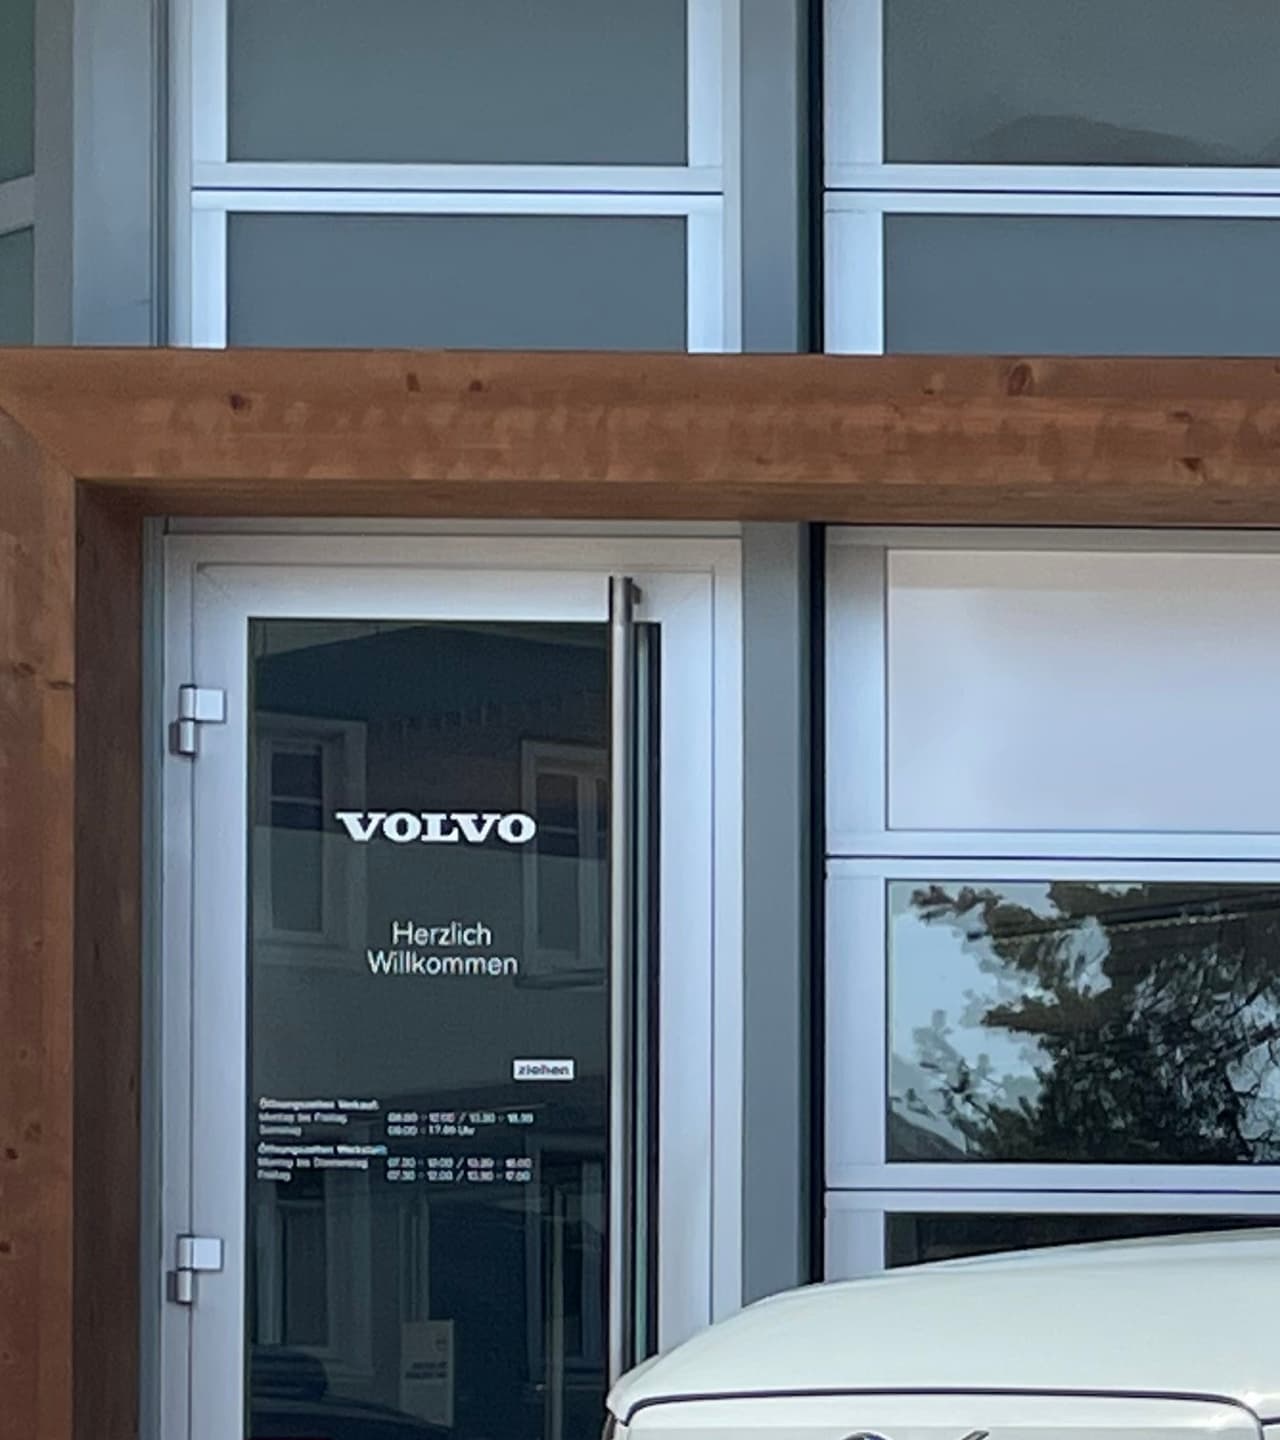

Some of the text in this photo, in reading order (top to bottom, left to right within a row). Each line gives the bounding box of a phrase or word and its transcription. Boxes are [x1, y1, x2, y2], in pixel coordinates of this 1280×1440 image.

[336, 812, 537, 843] VOLVO
[392, 921, 492, 946] Herzlich
[367, 950, 518, 976] Willkommen
[519, 1064, 570, 1075] ziehen
